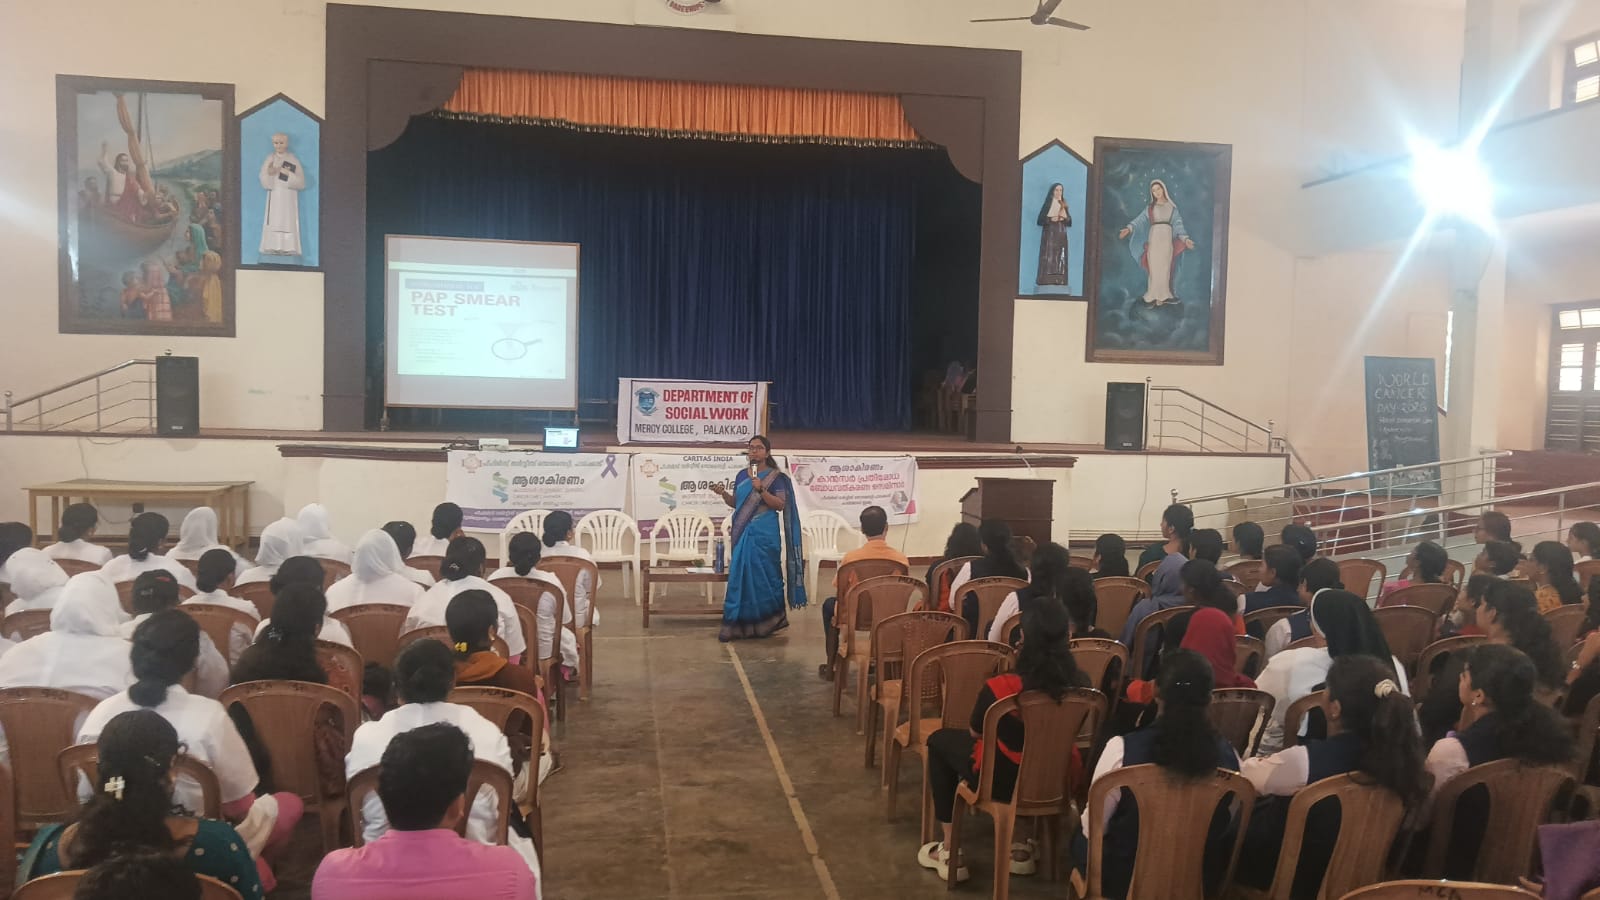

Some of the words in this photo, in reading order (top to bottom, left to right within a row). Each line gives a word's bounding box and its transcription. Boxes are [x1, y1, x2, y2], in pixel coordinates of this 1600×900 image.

[411, 291, 448, 304] PAP
[454, 293, 521, 307] SMEAR
[411, 303, 458, 317] TEST
[663, 389, 739, 403] DEPARTMENT
[740, 390, 754, 404] OF
[1374, 387, 1426, 400] CANCER
[665, 406, 708, 420] SOCIAL
[709, 407, 749, 420] WORK
[634, 423, 661, 434] MERCY
[512, 473, 585, 487] ആശാകിരണം
